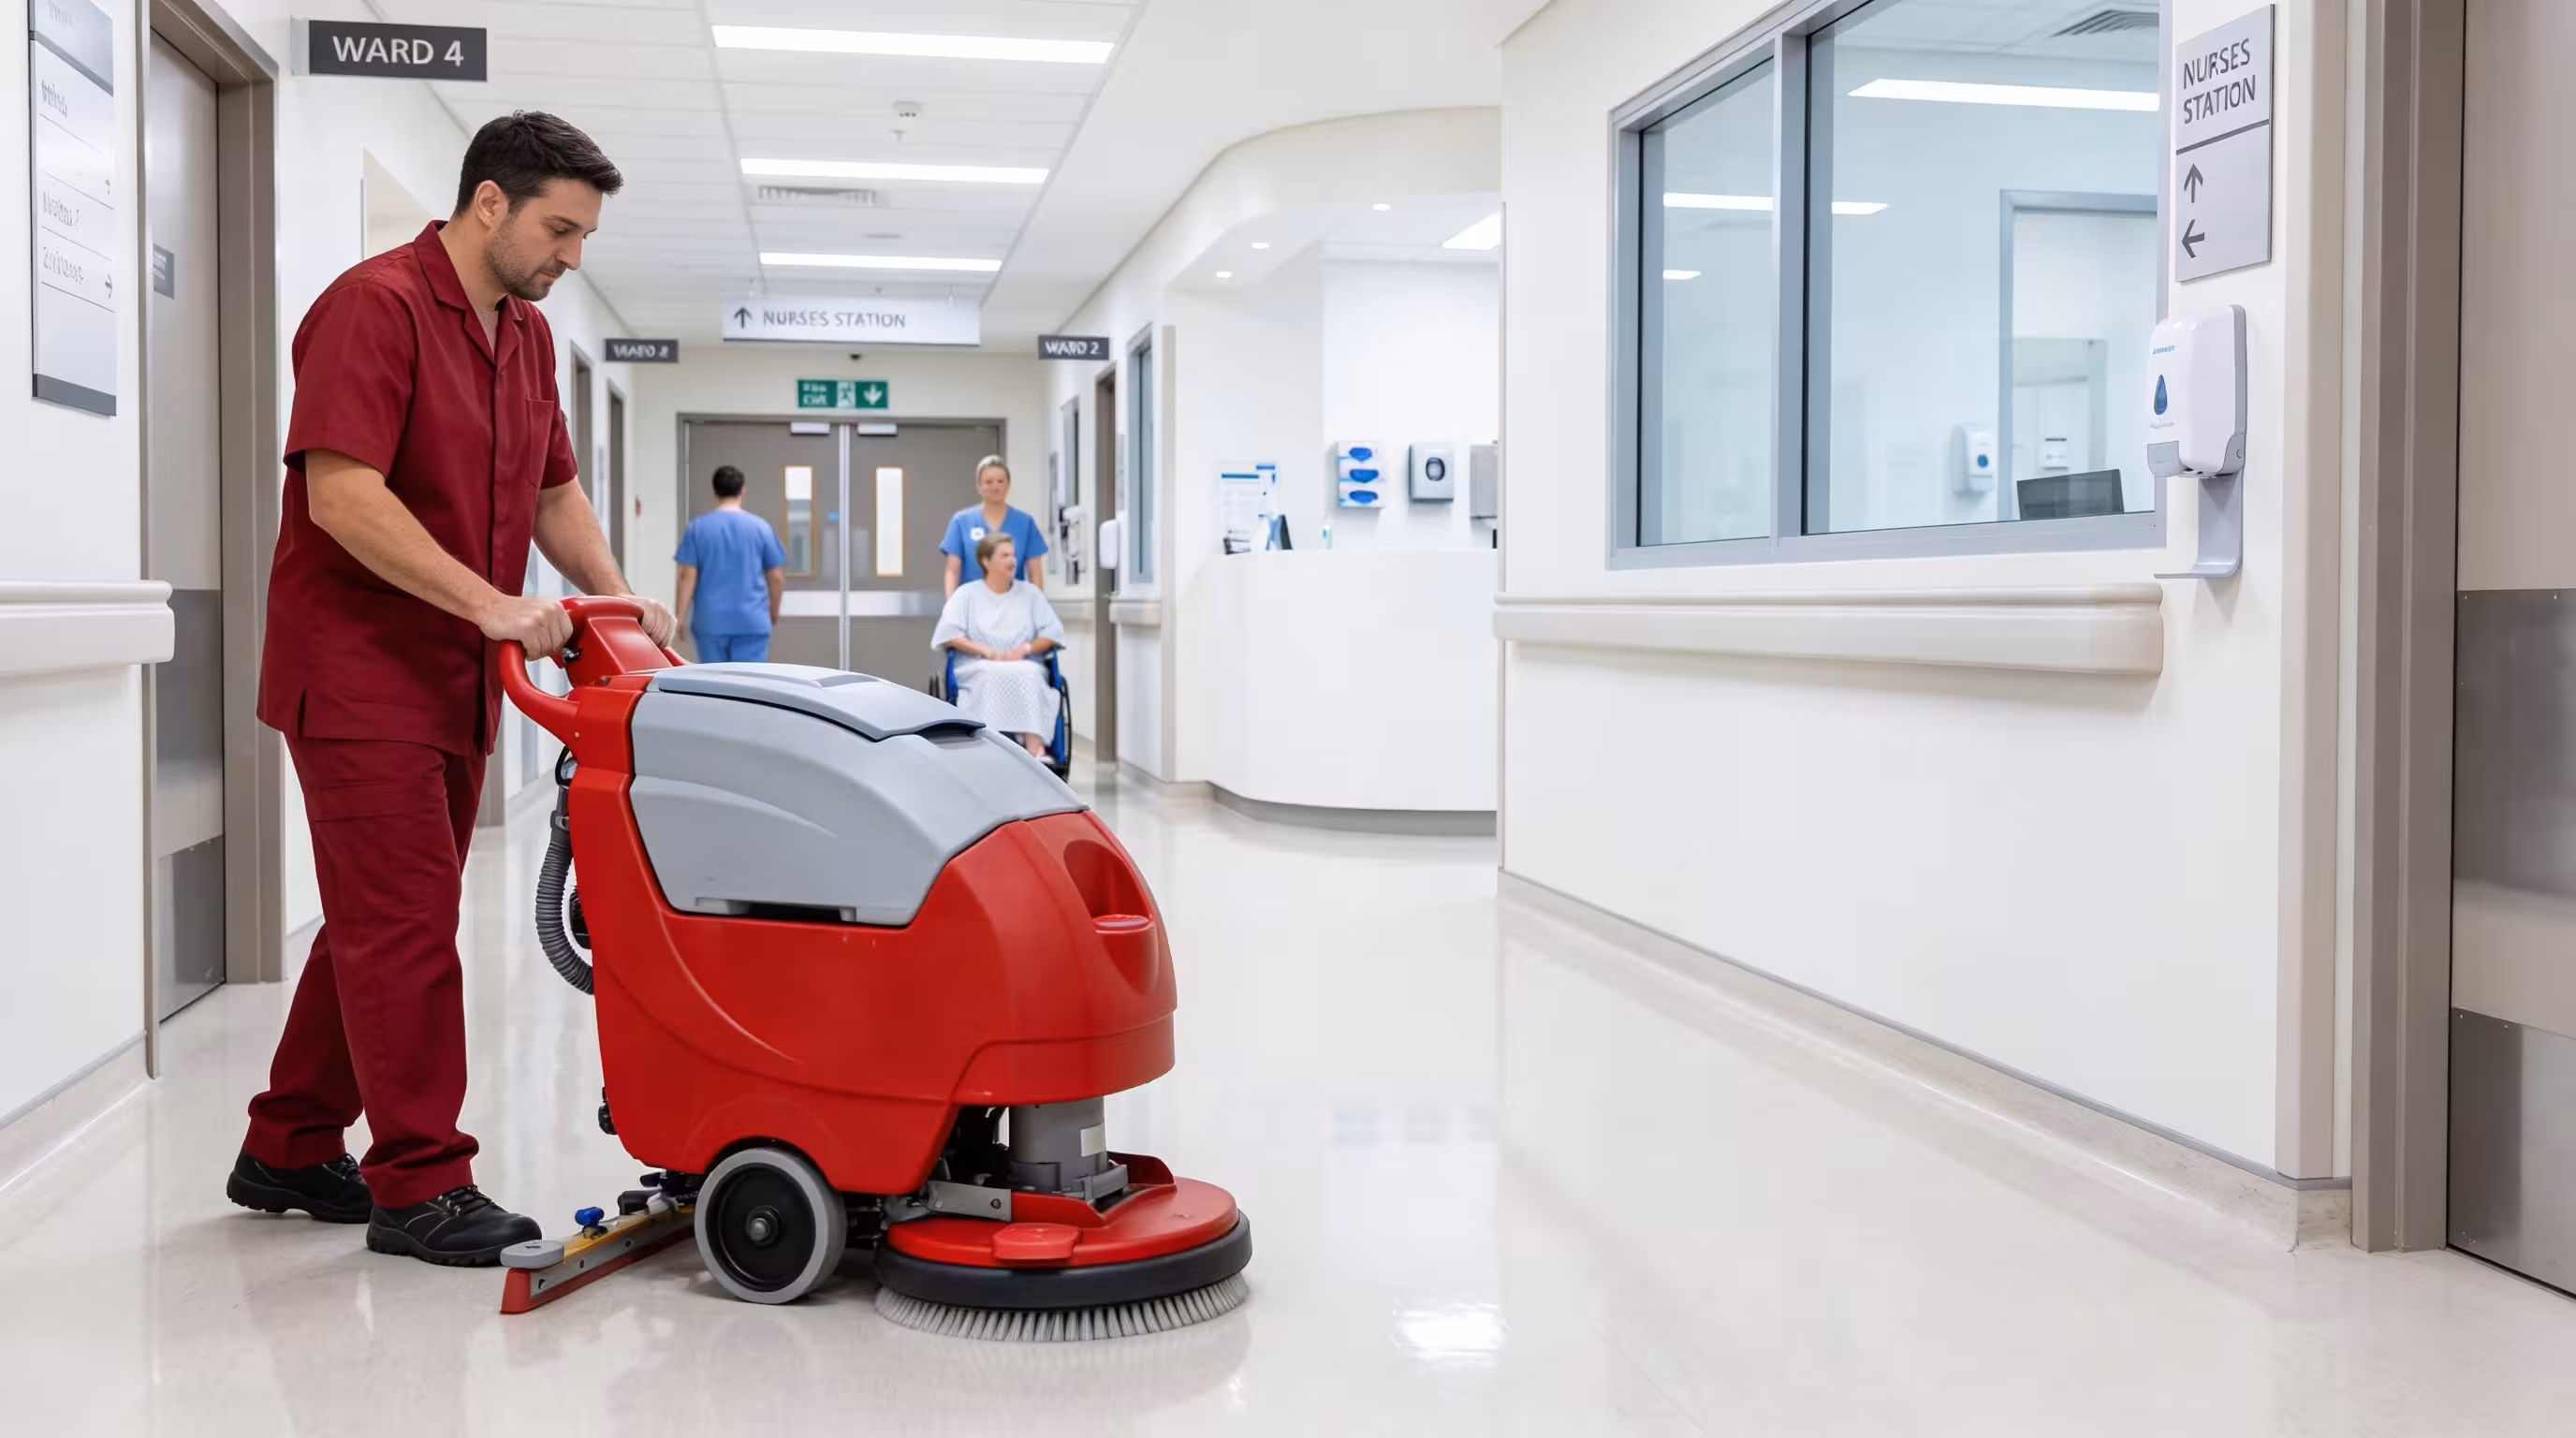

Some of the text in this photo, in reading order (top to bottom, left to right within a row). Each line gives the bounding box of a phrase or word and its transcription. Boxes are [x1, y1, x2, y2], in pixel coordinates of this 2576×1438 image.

[332, 36, 464, 67] WARD 4
[2183, 37, 2251, 90] NURSES
[2183, 74, 2256, 125] STATION
[763, 310, 906, 328] NURSES STATION
[1090, 341, 1100, 355] 2
